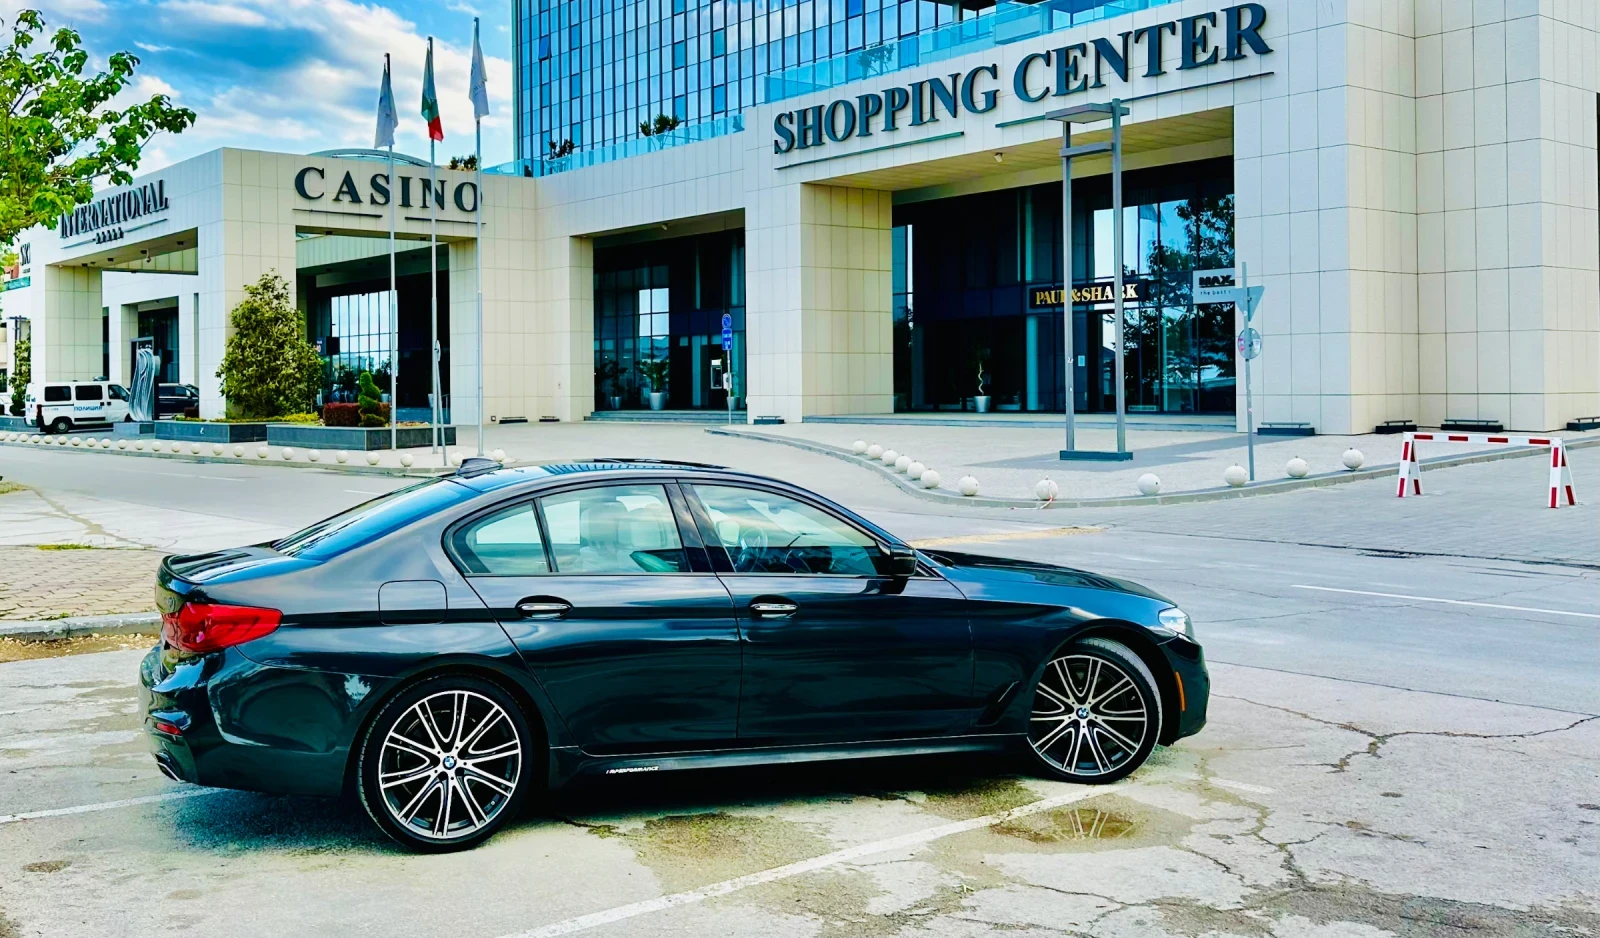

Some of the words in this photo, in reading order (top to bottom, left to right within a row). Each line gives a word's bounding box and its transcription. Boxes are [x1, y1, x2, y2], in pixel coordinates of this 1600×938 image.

[773, 63, 1000, 155] SHOPPING
[1013, 2, 1274, 102] CENTER
[59, 179, 170, 239] INTERNATIONAL
[294, 166, 482, 213] CASINO
